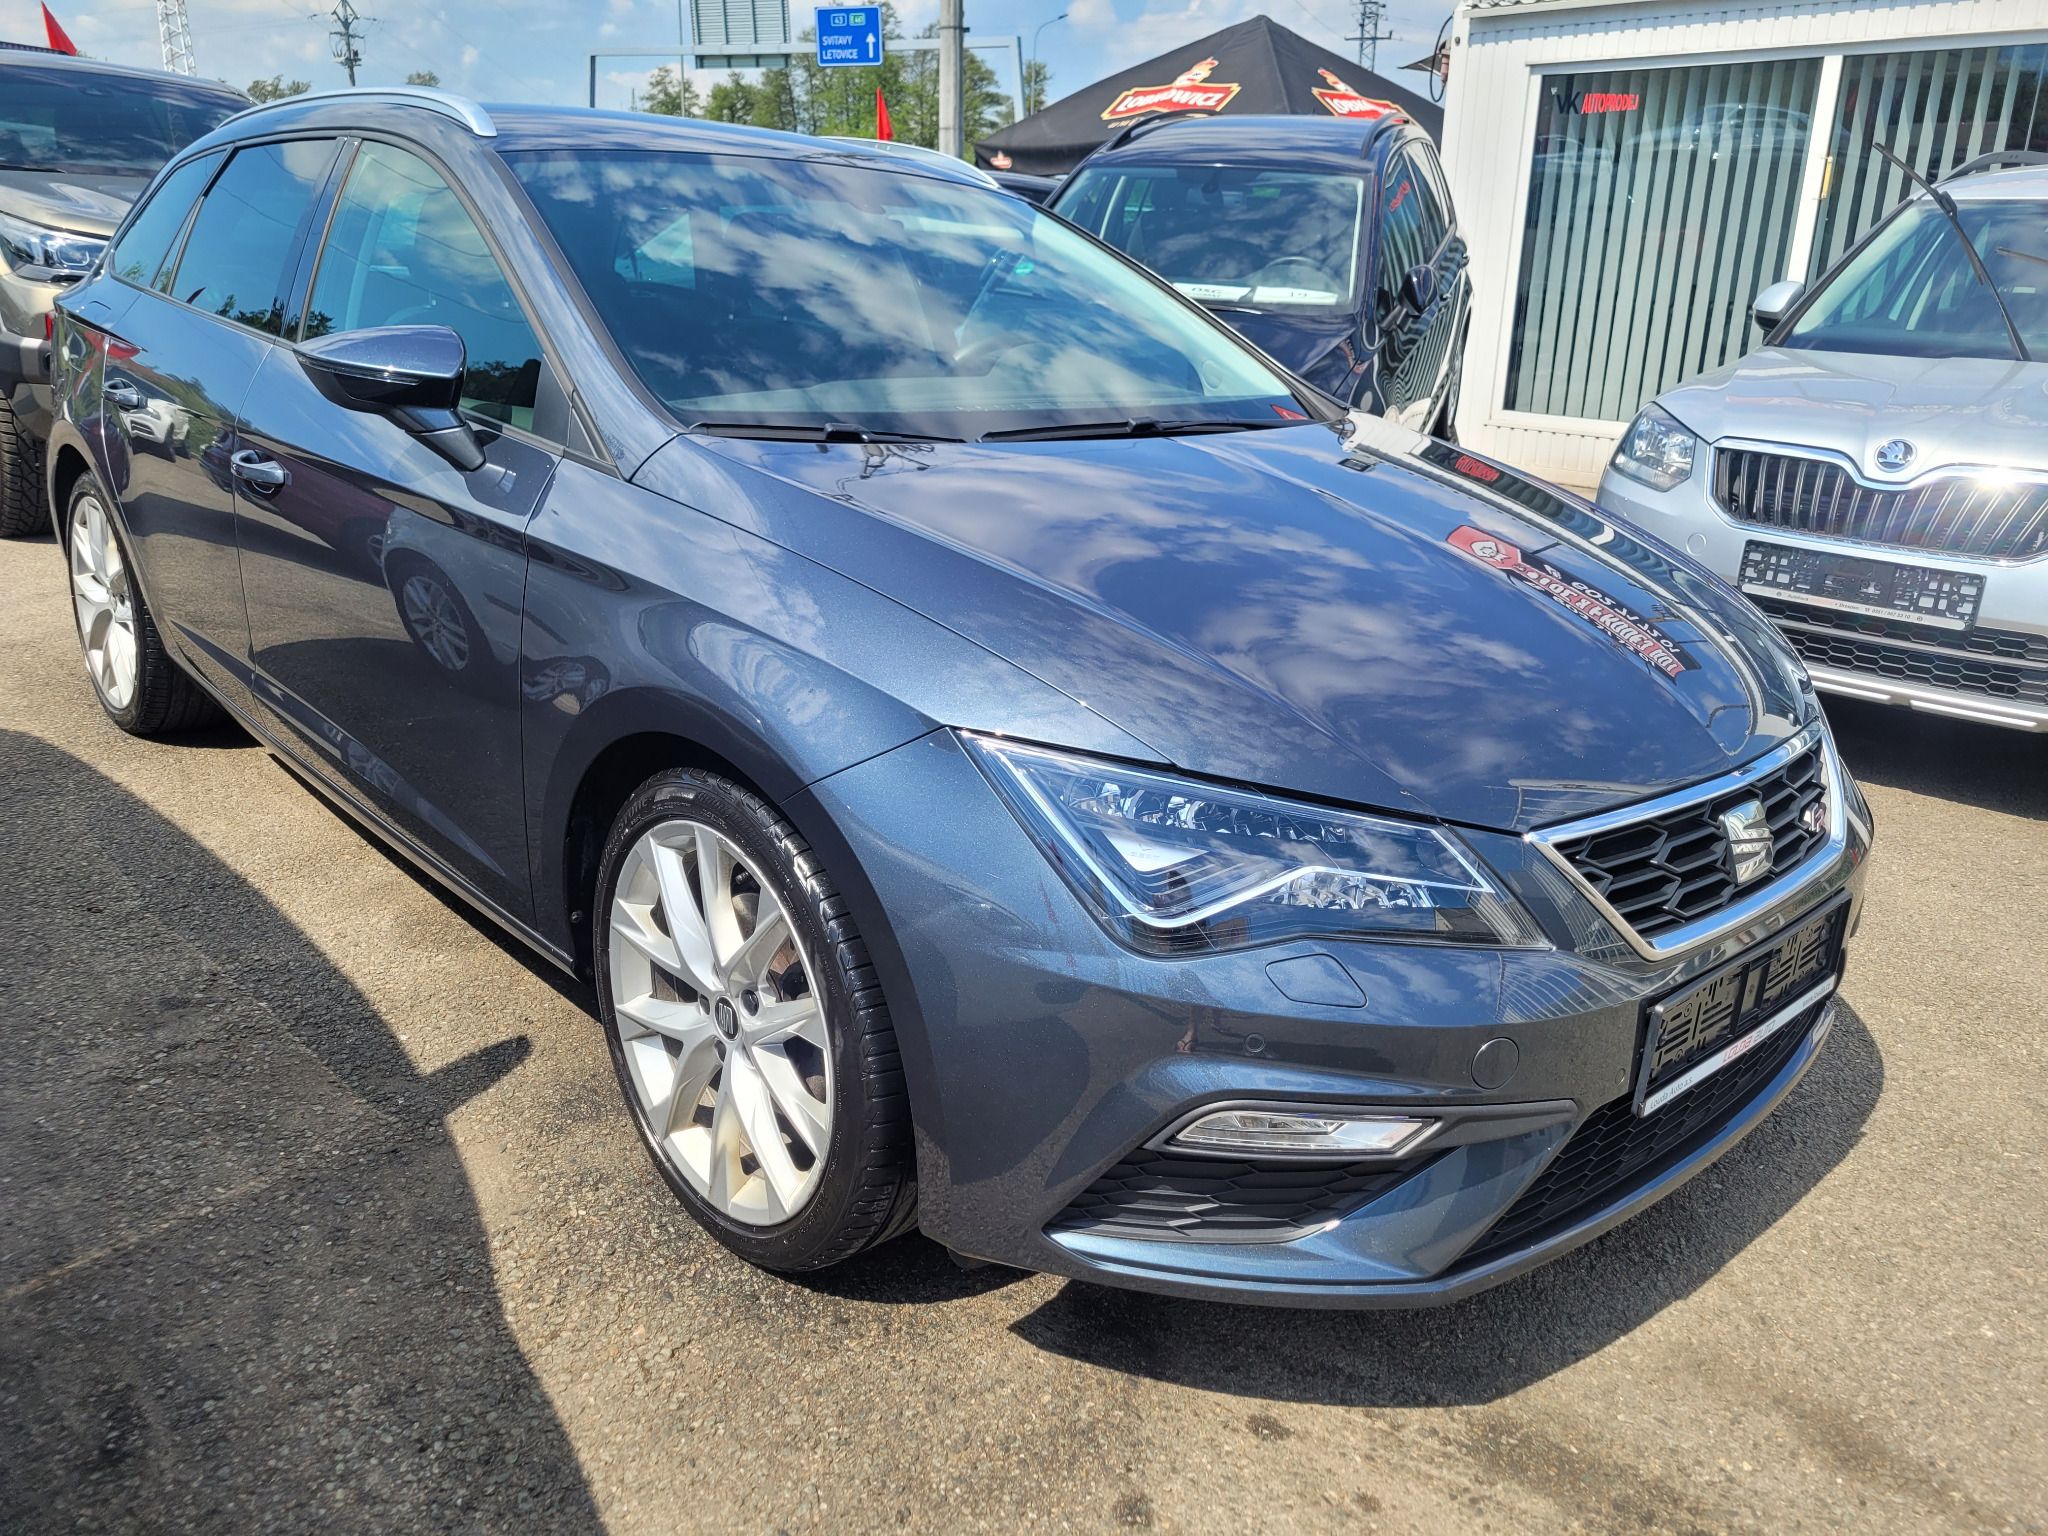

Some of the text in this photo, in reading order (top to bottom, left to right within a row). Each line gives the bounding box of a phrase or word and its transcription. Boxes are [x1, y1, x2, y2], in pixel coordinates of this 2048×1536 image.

[822, 35, 852, 46] SVITAVY
[822, 49, 858, 60] LETOVICE
[1556, 91, 1640, 114] VK AUTOPRODEJ
